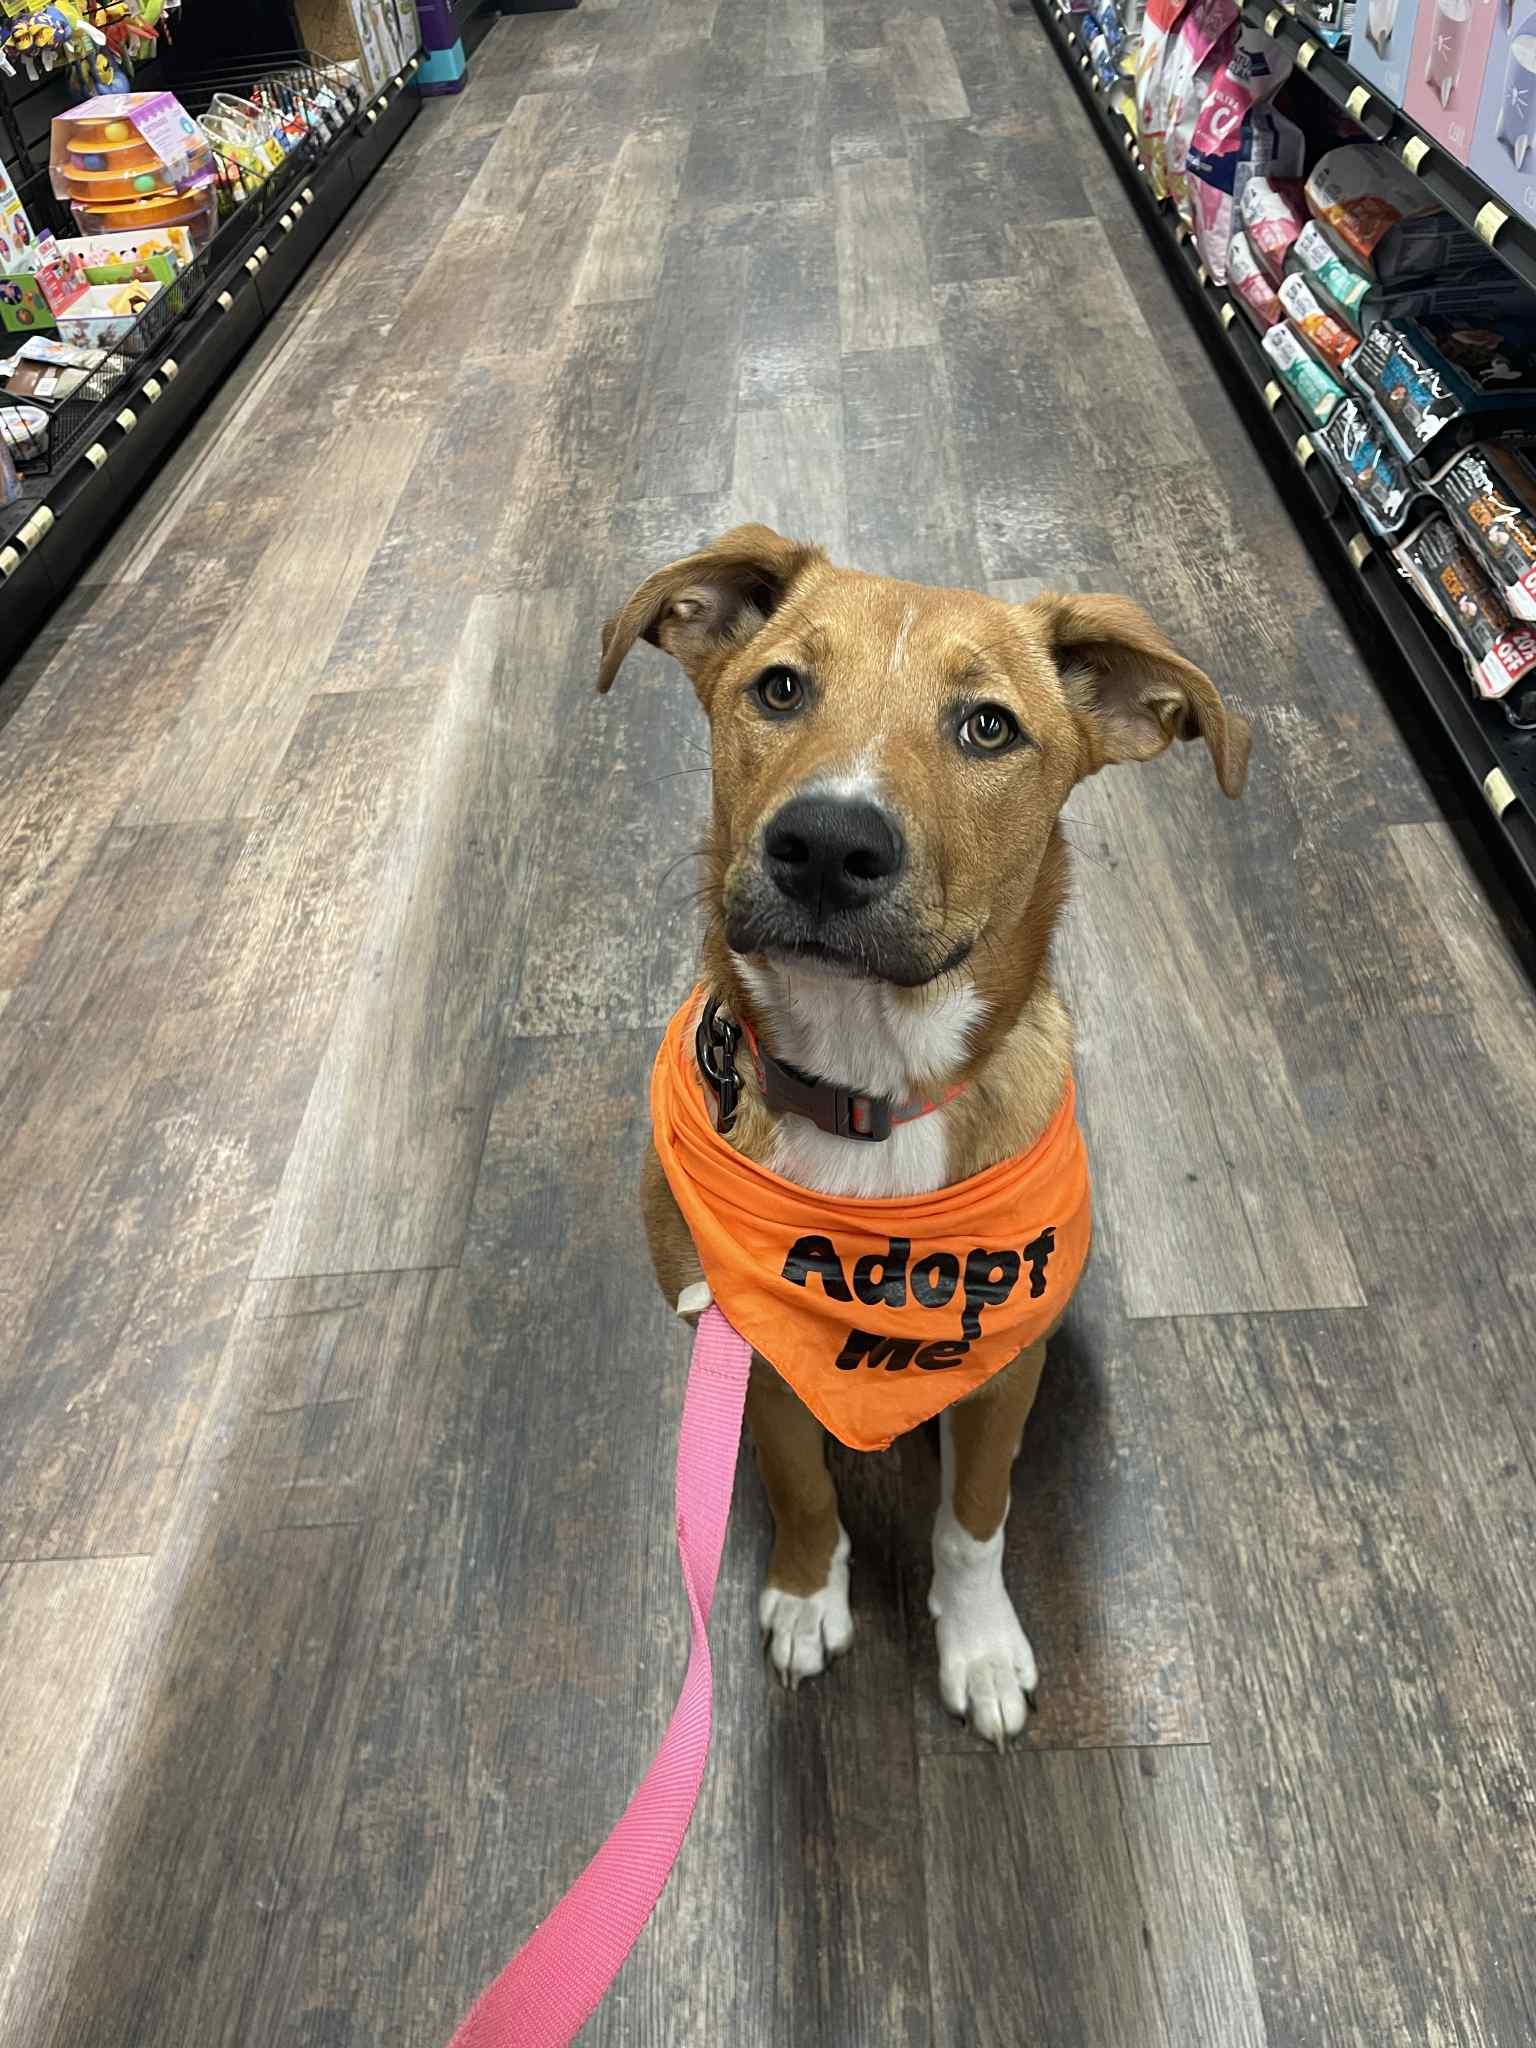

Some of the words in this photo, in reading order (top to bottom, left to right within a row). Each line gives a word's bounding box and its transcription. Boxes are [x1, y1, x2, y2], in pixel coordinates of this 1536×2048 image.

[1498, 642, 1525, 672] OFF
[781, 1226, 1057, 1340] Adopt
[835, 1329, 970, 1371] Me
